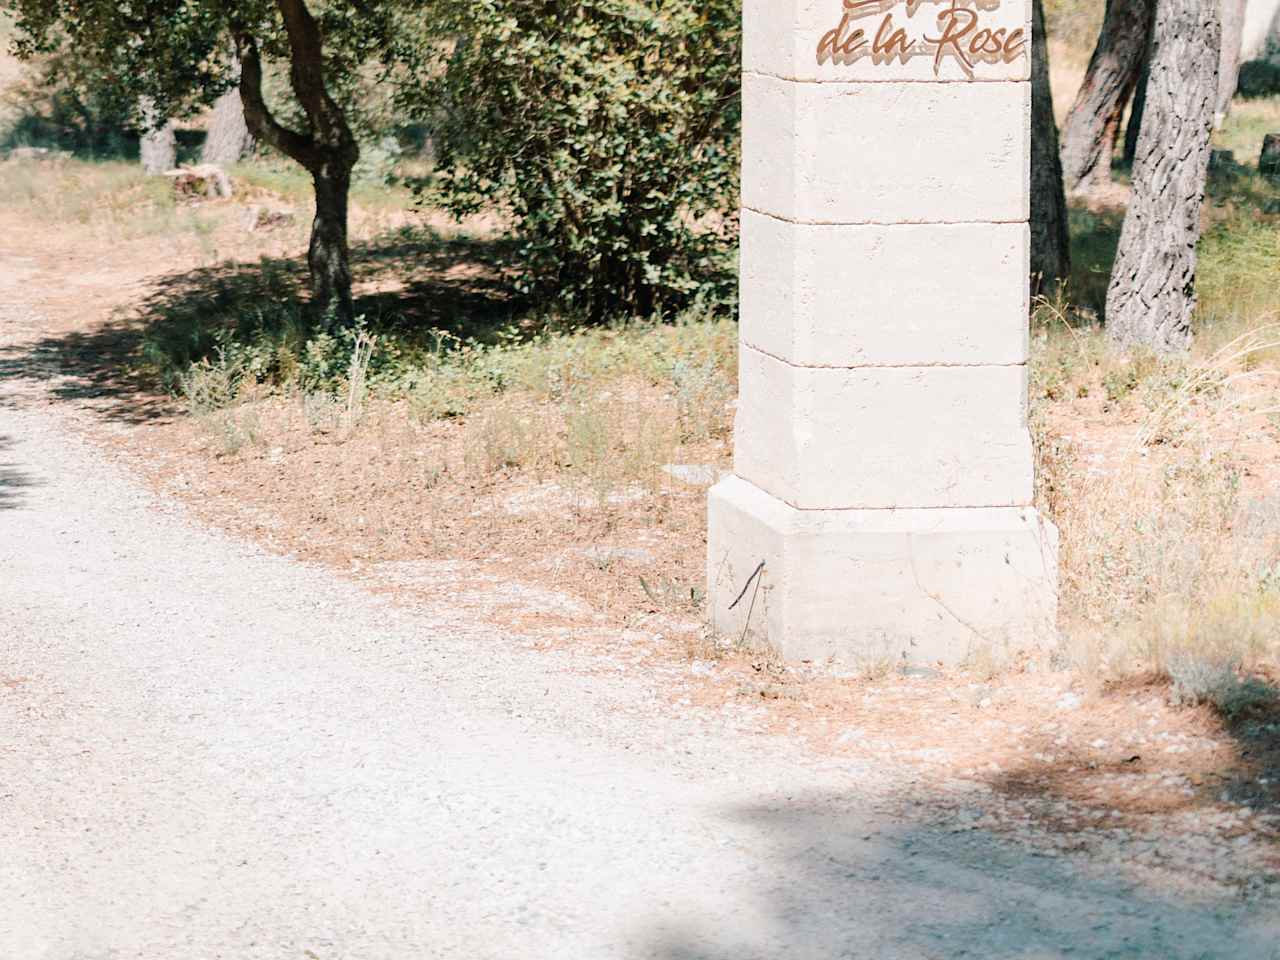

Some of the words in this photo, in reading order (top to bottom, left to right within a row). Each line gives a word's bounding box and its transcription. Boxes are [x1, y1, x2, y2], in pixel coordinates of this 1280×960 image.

[816, 12, 869, 57] de
[872, 12, 916, 56] la
[922, 7, 1028, 71] Rose
